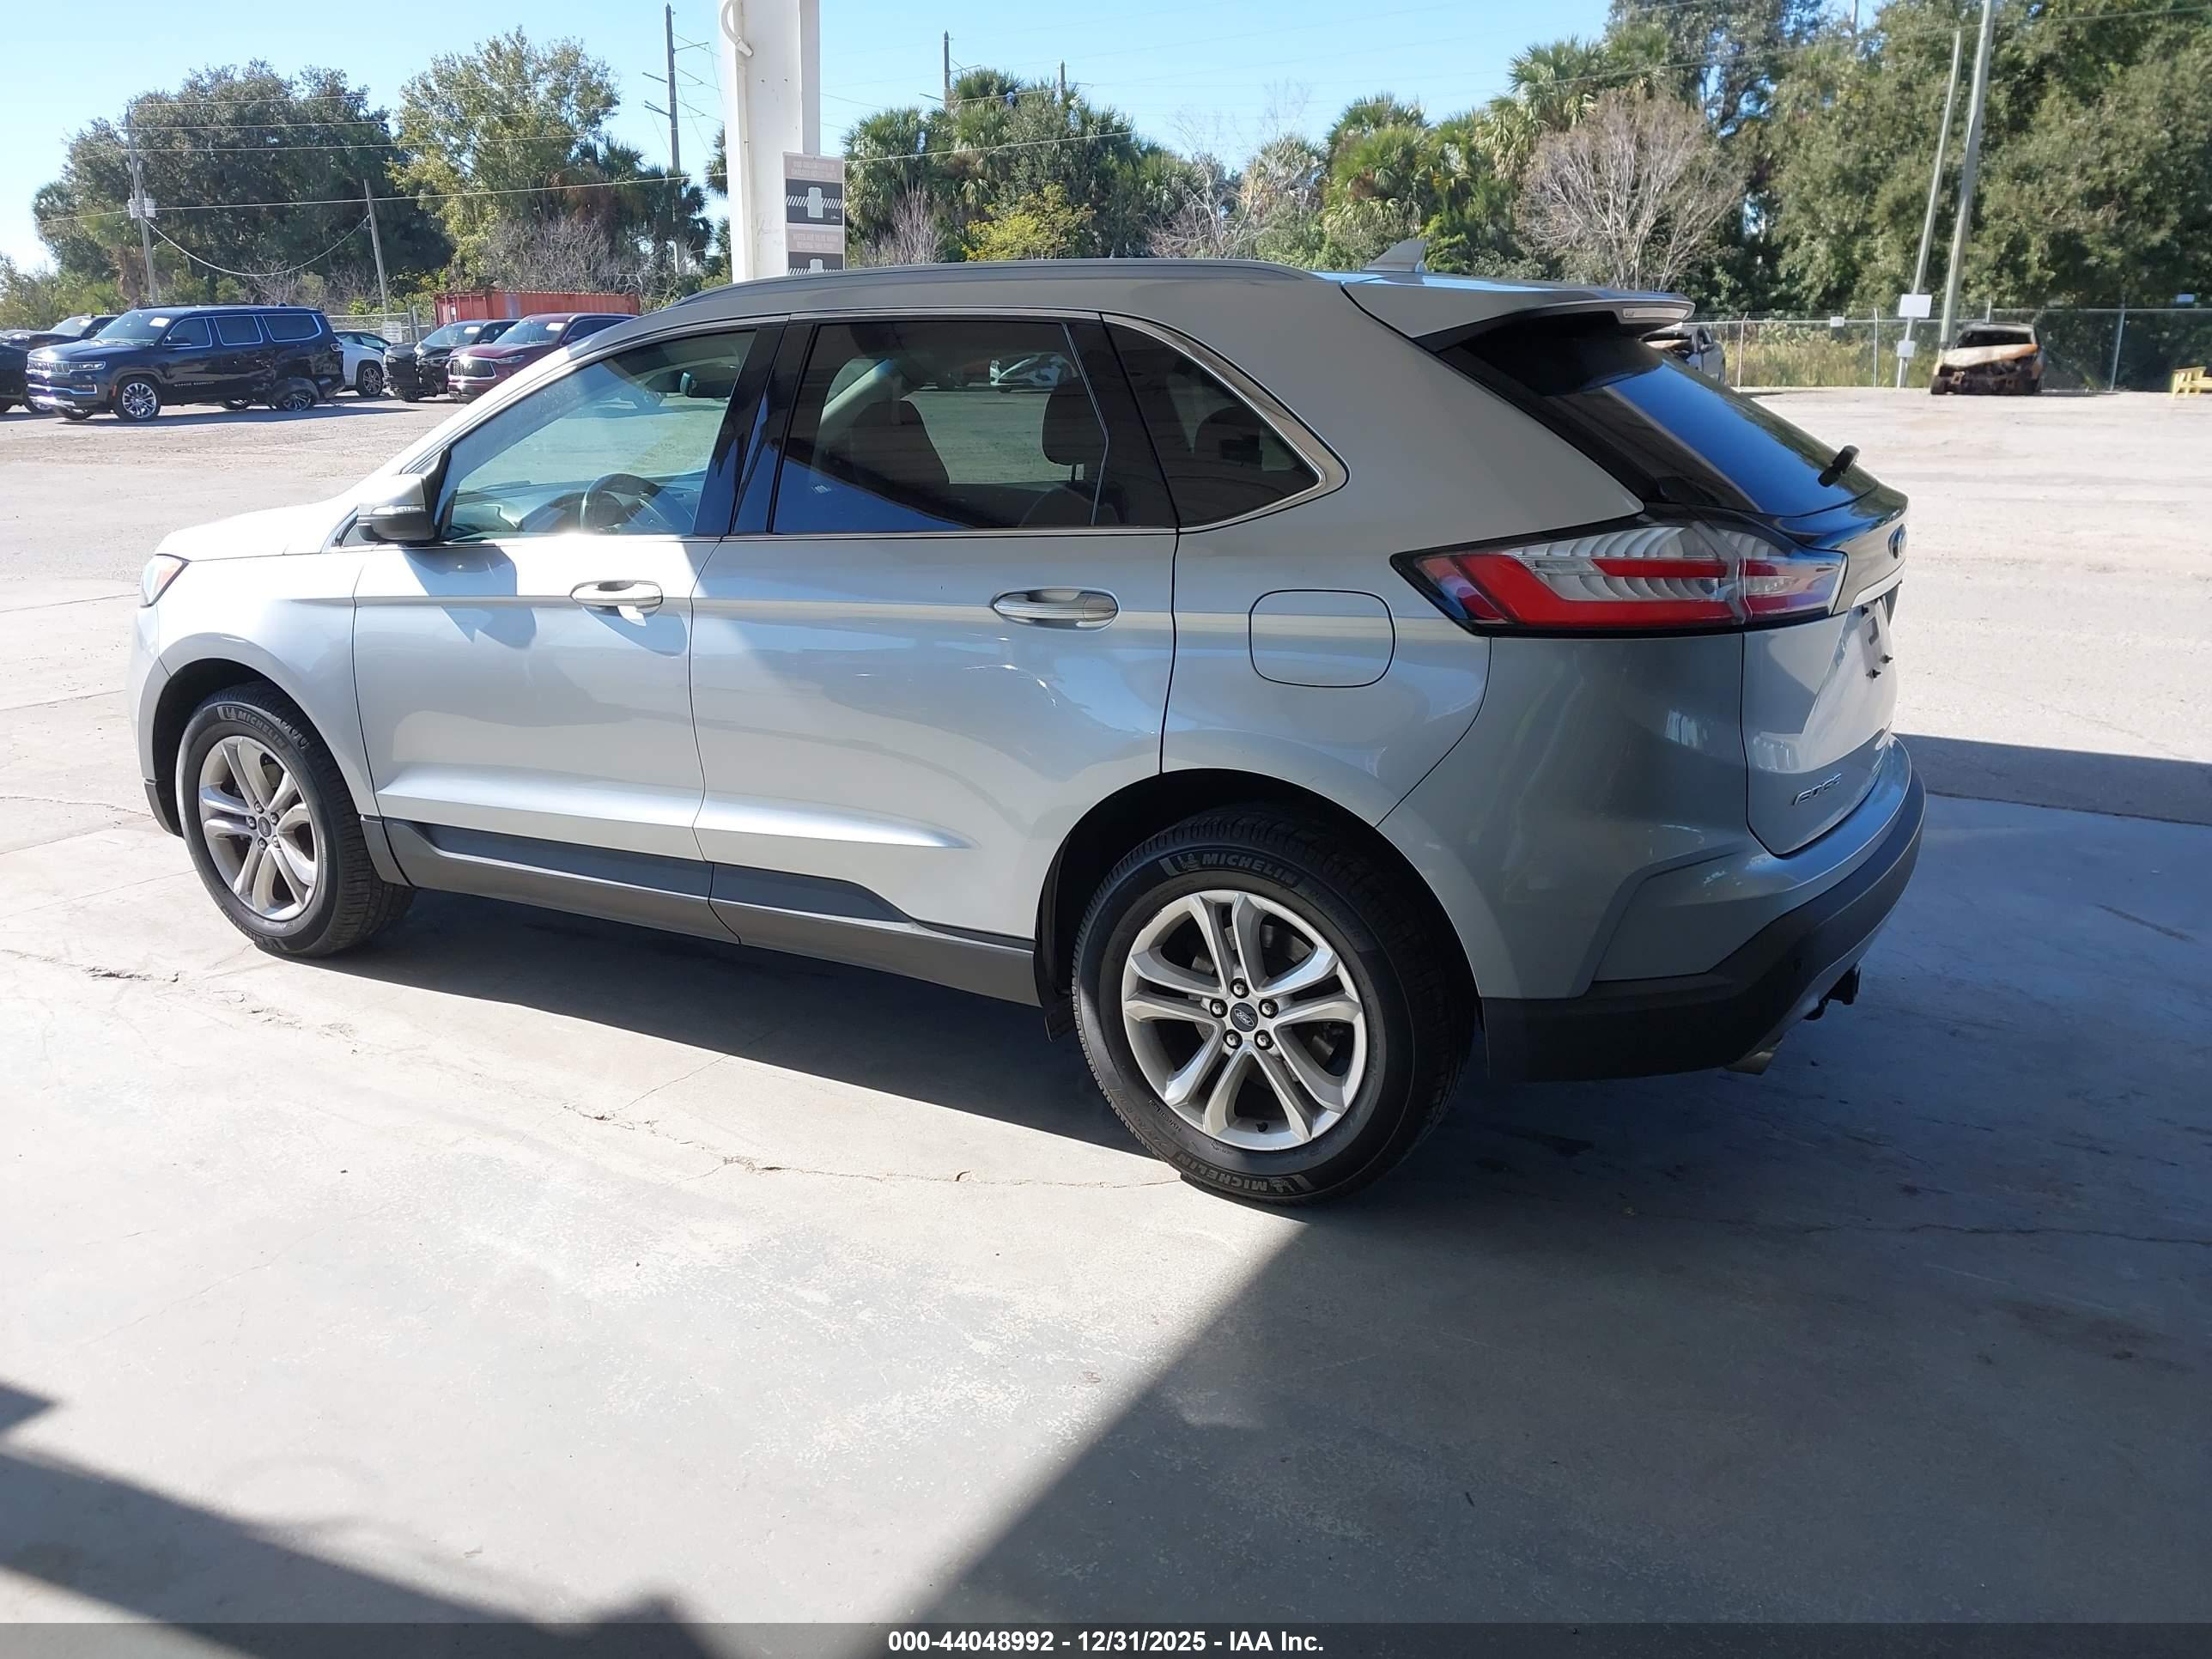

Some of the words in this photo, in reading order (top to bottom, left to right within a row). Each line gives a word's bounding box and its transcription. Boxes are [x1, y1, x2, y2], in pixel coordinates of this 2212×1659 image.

[238, 711, 286, 749] MICHELIN
[1202, 853, 1298, 887] MICHELIN
[1177, 1153, 1267, 1192] MICHELIN
